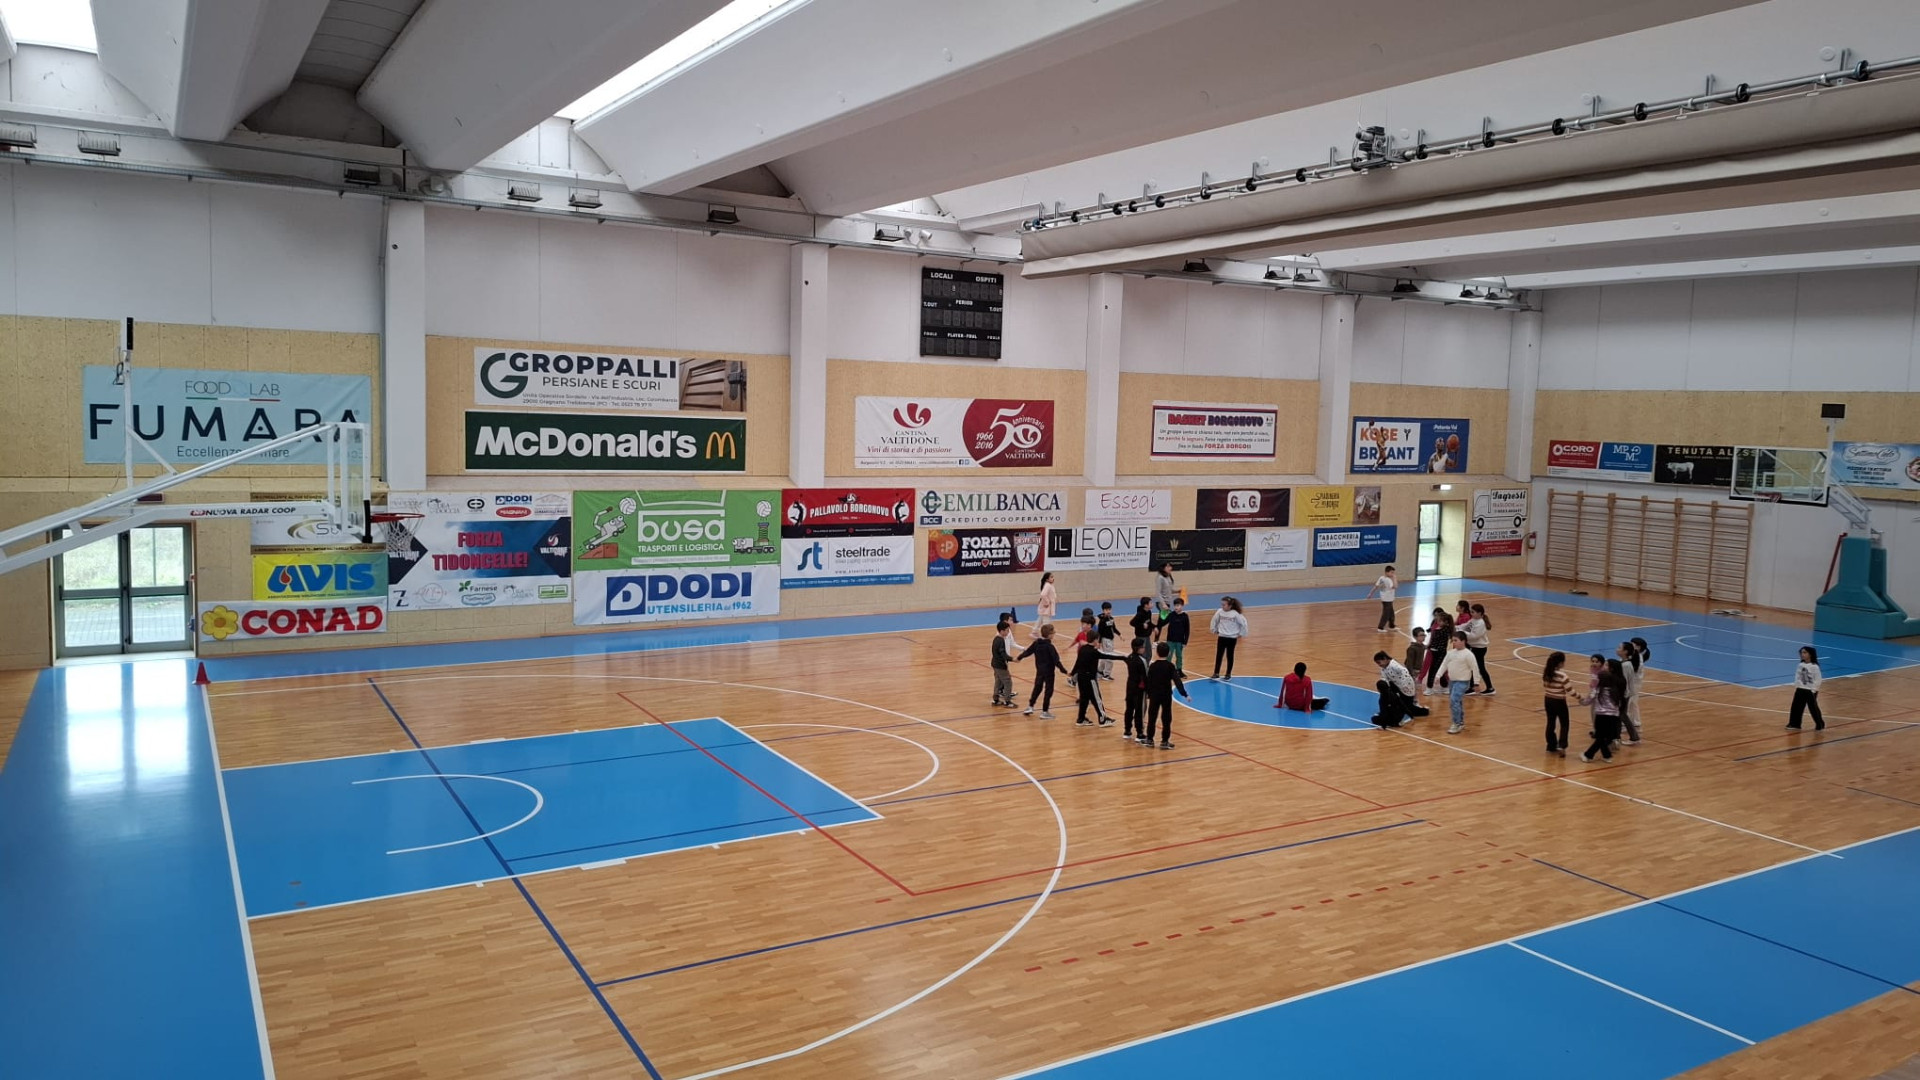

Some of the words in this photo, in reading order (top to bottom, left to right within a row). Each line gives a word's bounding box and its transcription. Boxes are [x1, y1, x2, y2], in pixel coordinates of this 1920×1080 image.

[509, 352, 676, 378] GROPPALLI
[186, 380, 231, 394] FOOD
[250, 383, 280, 396] LAB
[542, 376, 608, 388] PERSIANE
[612, 380, 619, 389] E
[624, 380, 661, 390] SCURI
[1168, 414, 1206, 425] BASKET
[1208, 415, 1264, 427] BORGONOVO
[474, 426, 697, 458] McDonald's
[881, 436, 940, 444] VALTIDONE
[976, 432, 994, 441] 1966
[1360, 428, 1398, 442] KOBE
[975, 441, 994, 449] 2016
[1563, 445, 1594, 453] CORO
[1668, 447, 1713, 455] TENUTA
[1359, 447, 1415, 460] BRANT
[944, 493, 1060, 512] EMILBANCA
[1101, 490, 1156, 515] Essegi
[810, 504, 848, 518] PALLAVOLO
[850, 503, 889, 517] BORGONOVO
[638, 510, 725, 542] busa
[458, 532, 504, 547] FORZA
[962, 536, 1011, 549] FORZA
[1054, 535, 1068, 551] IL
[1074, 527, 1147, 557] LEONE
[638, 545, 677, 553] TRASPORTI
[685, 544, 724, 552] LOGISTICA
[835, 546, 890, 558] steeltrade
[962, 549, 1011, 559] RAGAZZE
[432, 552, 528, 571] TIDONCELLE!
[268, 564, 375, 592] AVIS
[648, 572, 752, 601] DODI
[647, 603, 723, 615] UTENSILERIA
[732, 602, 752, 610] 1962
[242, 605, 383, 635] CONAD
